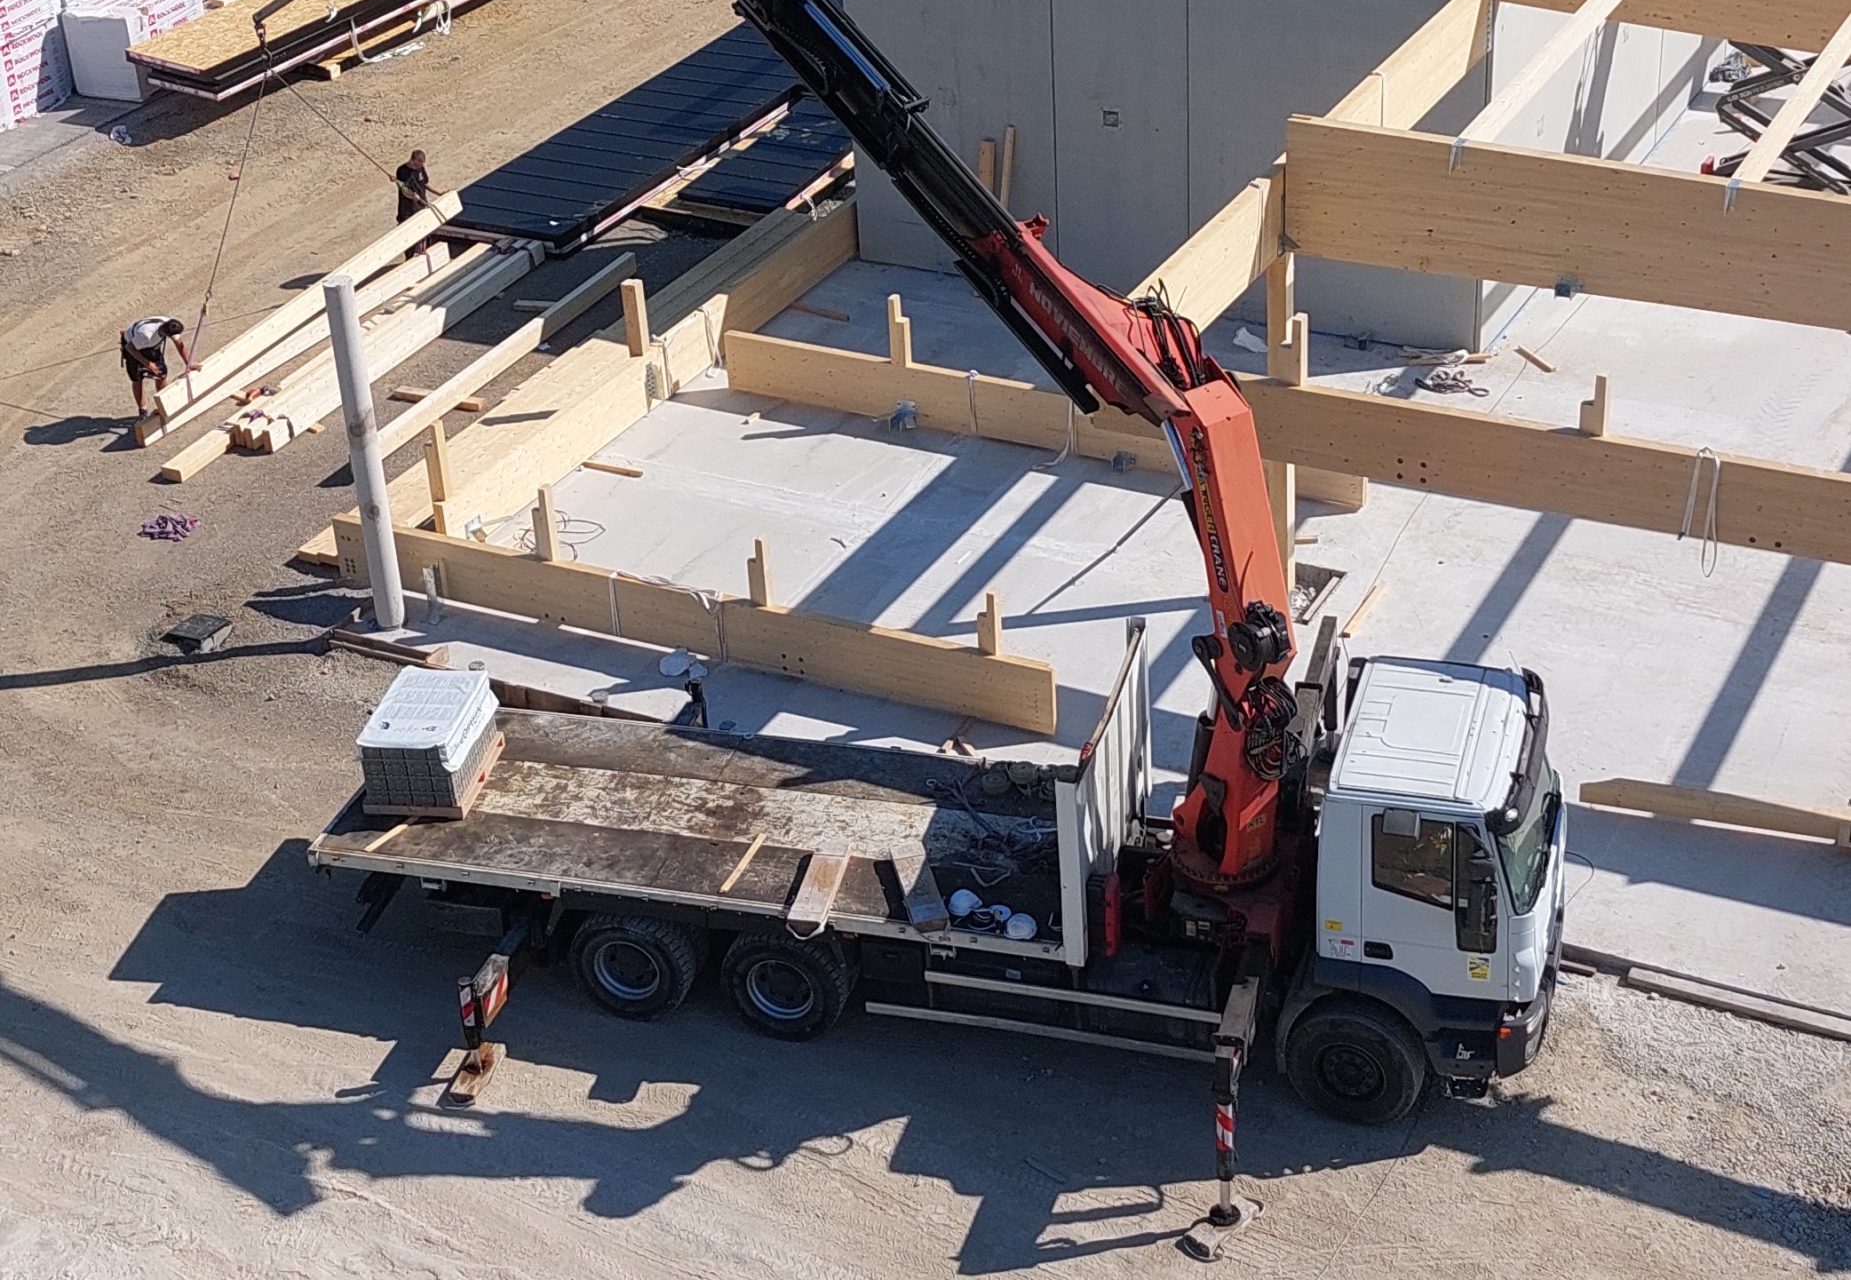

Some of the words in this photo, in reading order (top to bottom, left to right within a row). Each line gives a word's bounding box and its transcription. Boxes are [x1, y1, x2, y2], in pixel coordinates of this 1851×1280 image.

[12, 31, 43, 50] ROCKWOOL
[14, 47, 46, 65] ROCKWOOL
[17, 60, 49, 80] ROCKWOOL
[20, 75, 52, 95] ROCKWOOL
[1209, 534, 1227, 588] CRANE
